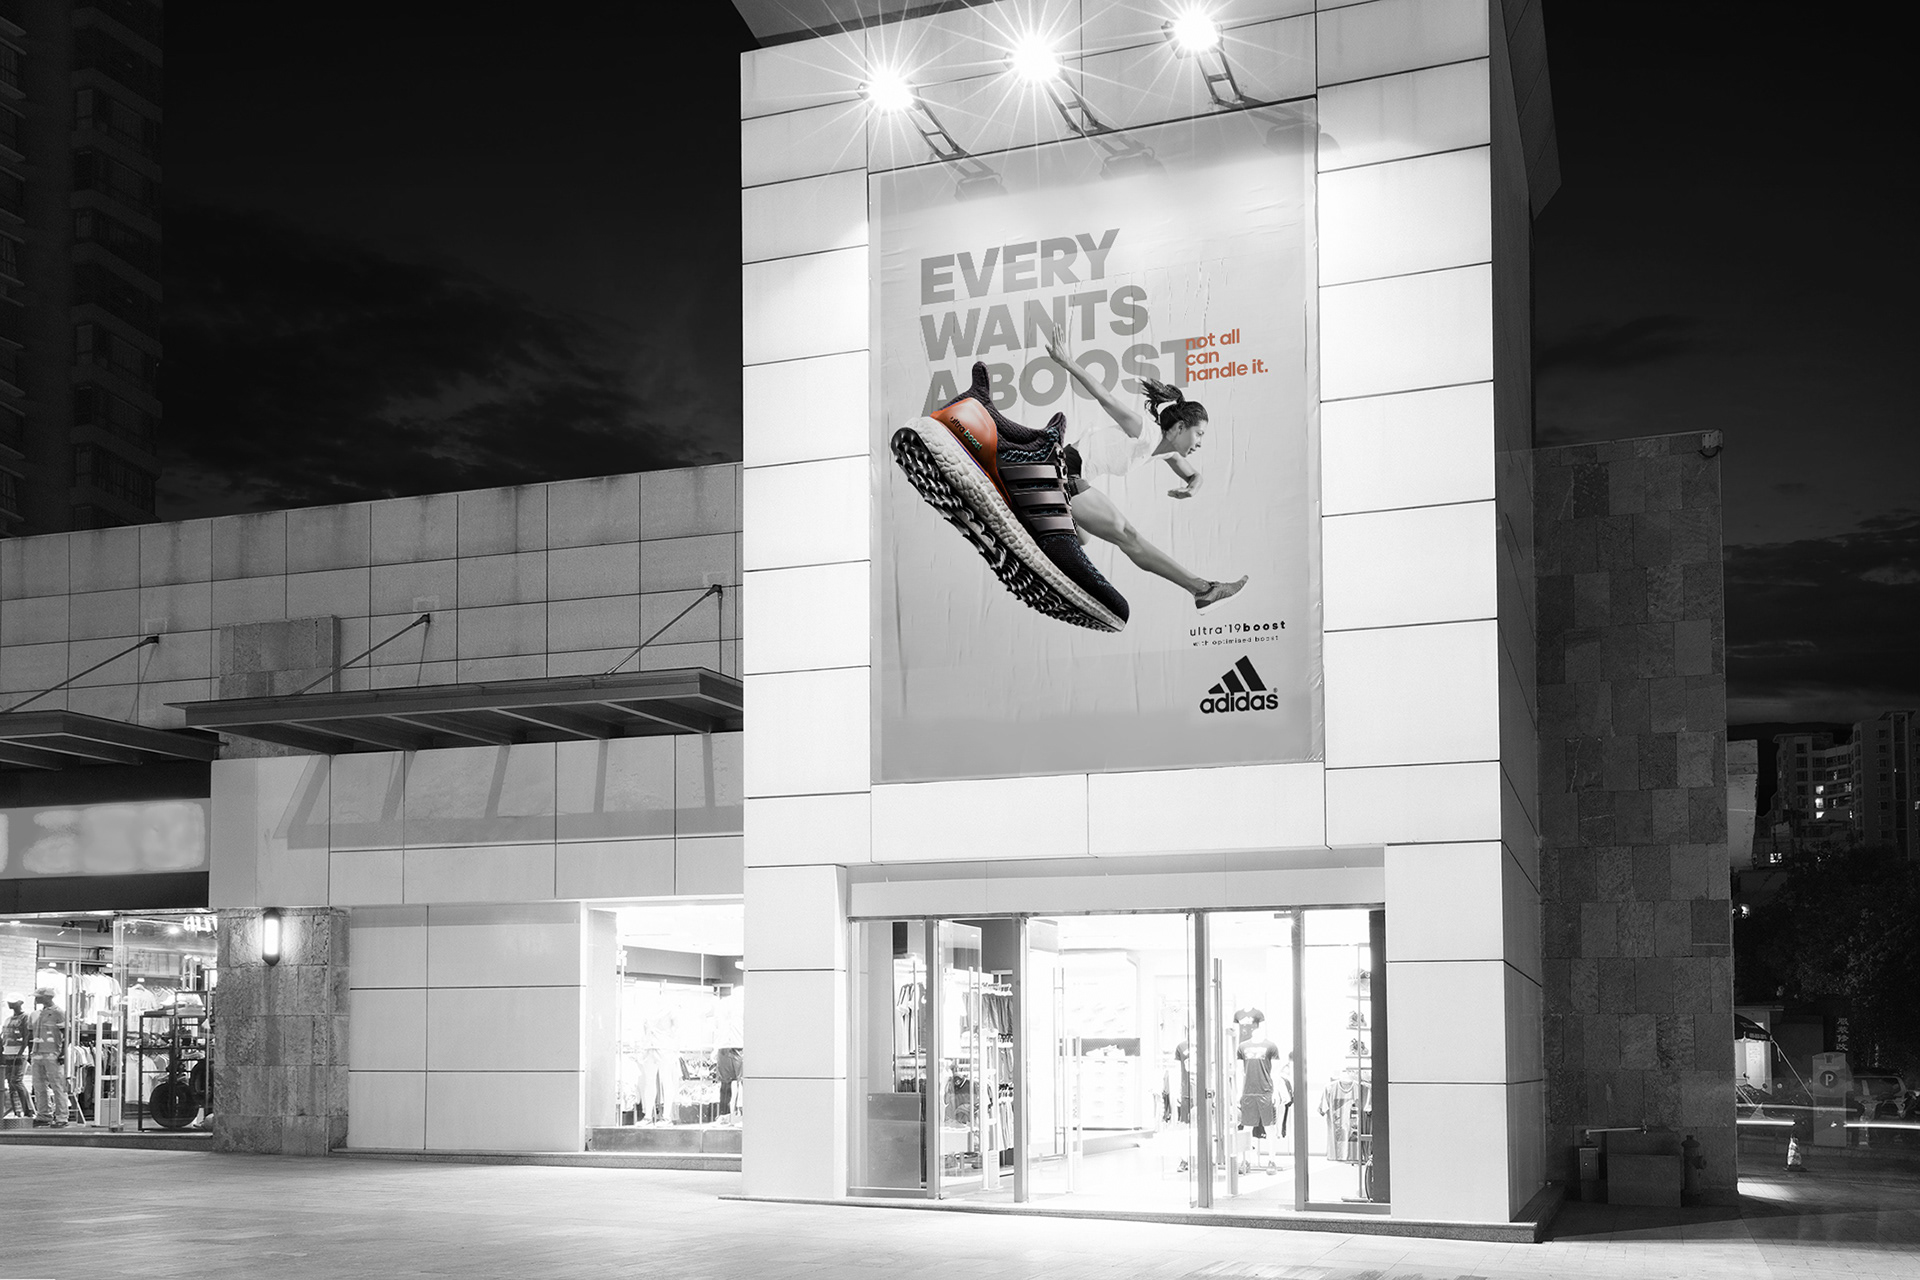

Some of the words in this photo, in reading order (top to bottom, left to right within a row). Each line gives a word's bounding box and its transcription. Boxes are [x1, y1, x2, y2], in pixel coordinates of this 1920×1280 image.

[921, 228, 1120, 305] EVERY
[920, 285, 1149, 361] WANTS
[1185, 333, 1215, 350] not
[1220, 328, 1240, 345] all
[1185, 351, 1219, 366] can
[1186, 361, 1248, 382] handle
[1252, 358, 1268, 374] it.
[985, 336, 1201, 411] BOOST
[950, 416, 965, 433] ultra
[964, 428, 983, 451] boost
[1199, 691, 1279, 714] adidas
[1825, 1074, 1834, 1086] P
